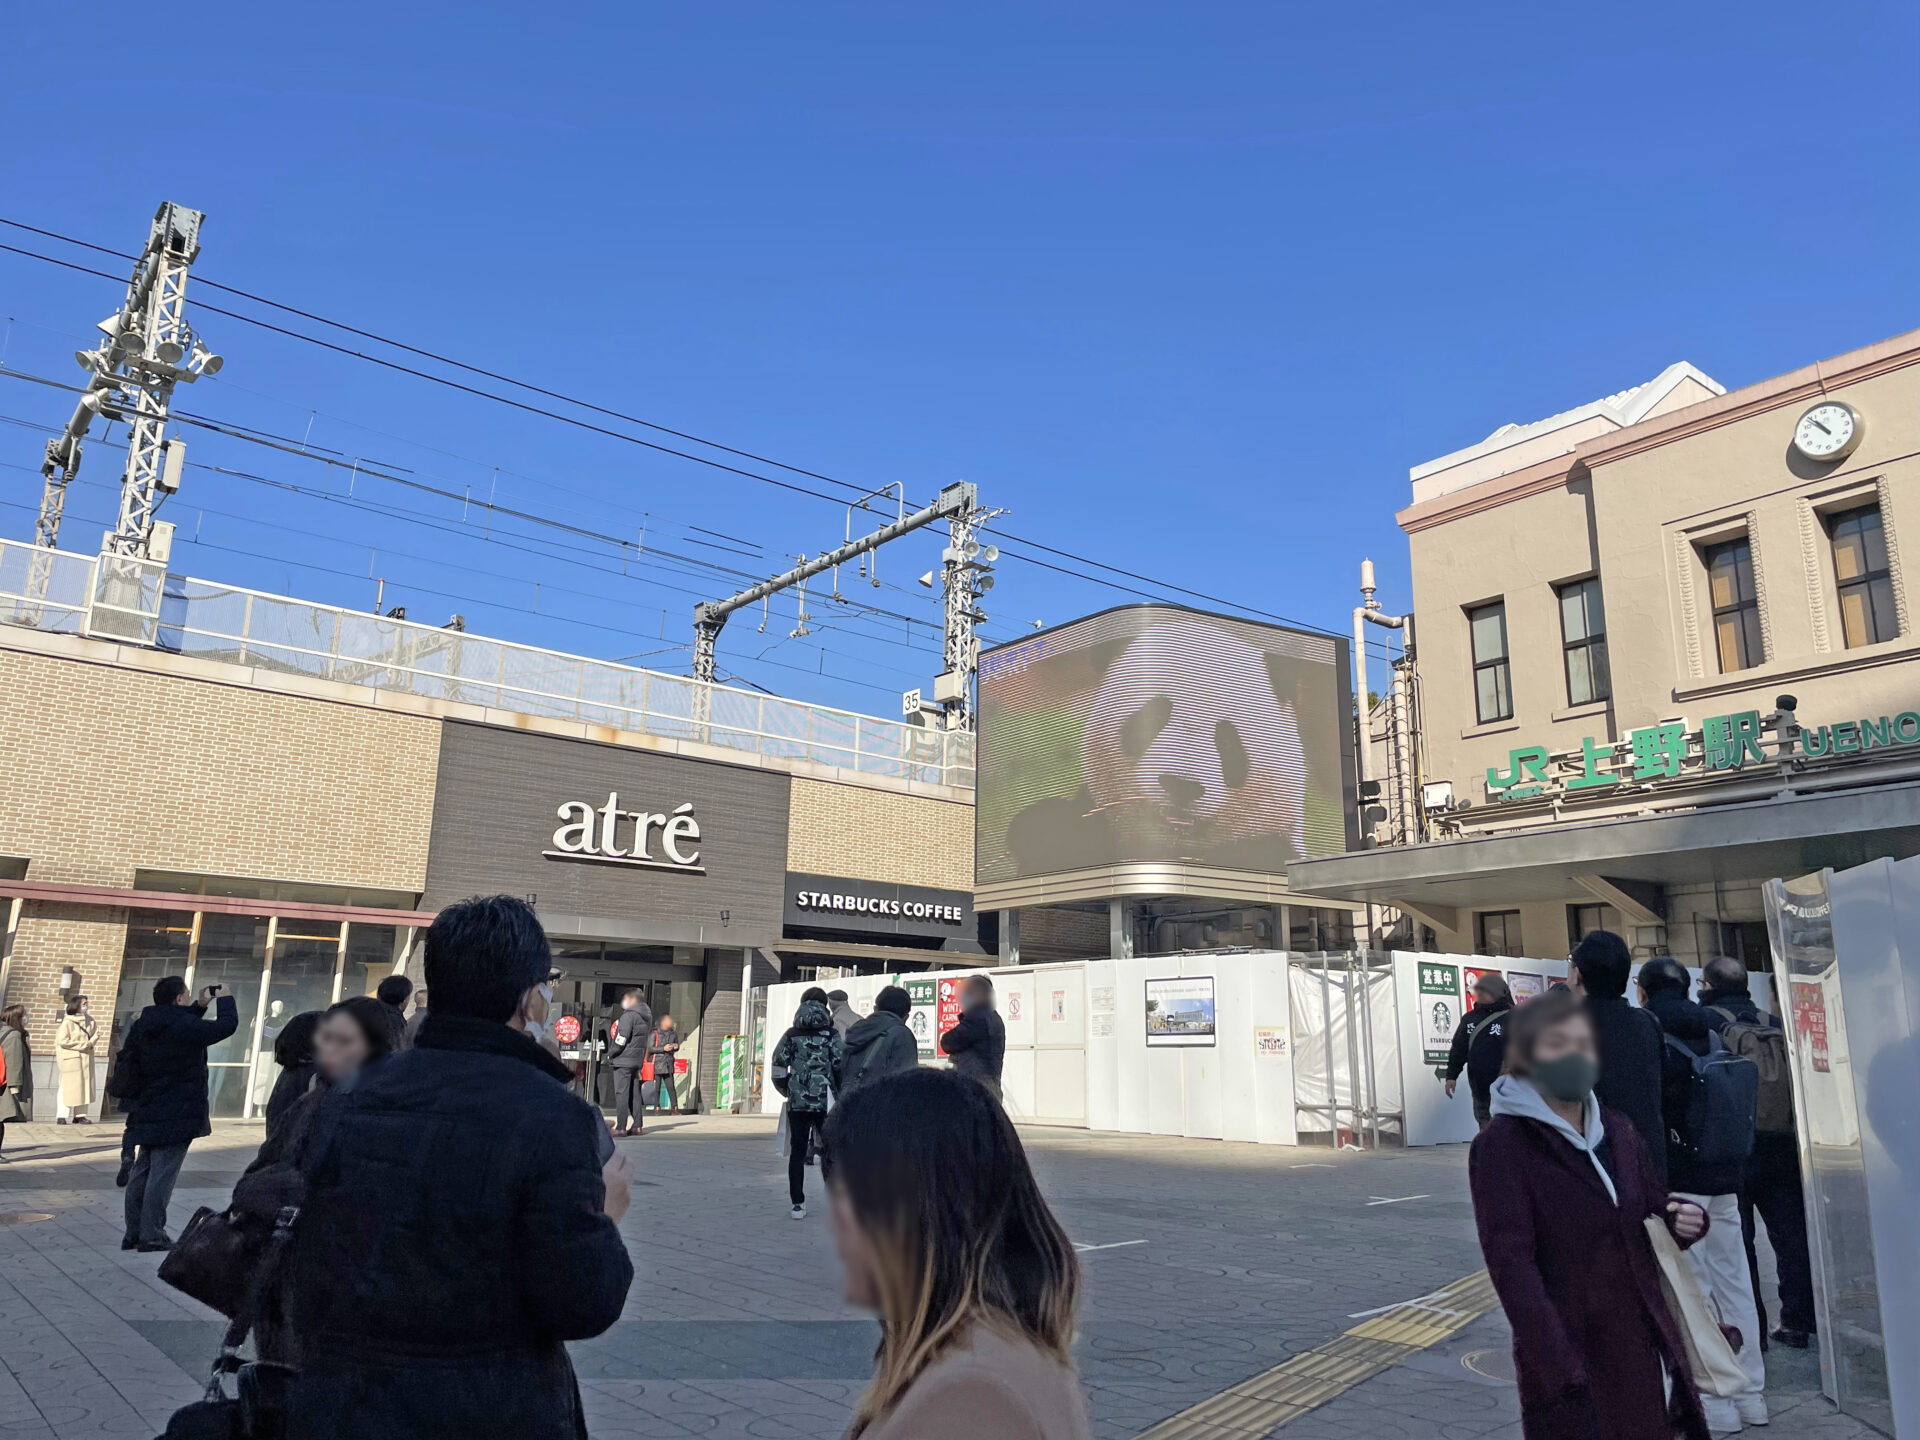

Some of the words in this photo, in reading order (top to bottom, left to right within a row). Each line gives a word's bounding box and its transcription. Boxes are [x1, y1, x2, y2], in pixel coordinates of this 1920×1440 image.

[905, 692, 918, 710] 35
[1800, 711, 1920, 757] UENO
[552, 791, 700, 865] atré
[797, 891, 900, 915] STARBUCKS
[902, 901, 962, 921] COFFEE
[1423, 968, 1452, 986] 営業中
